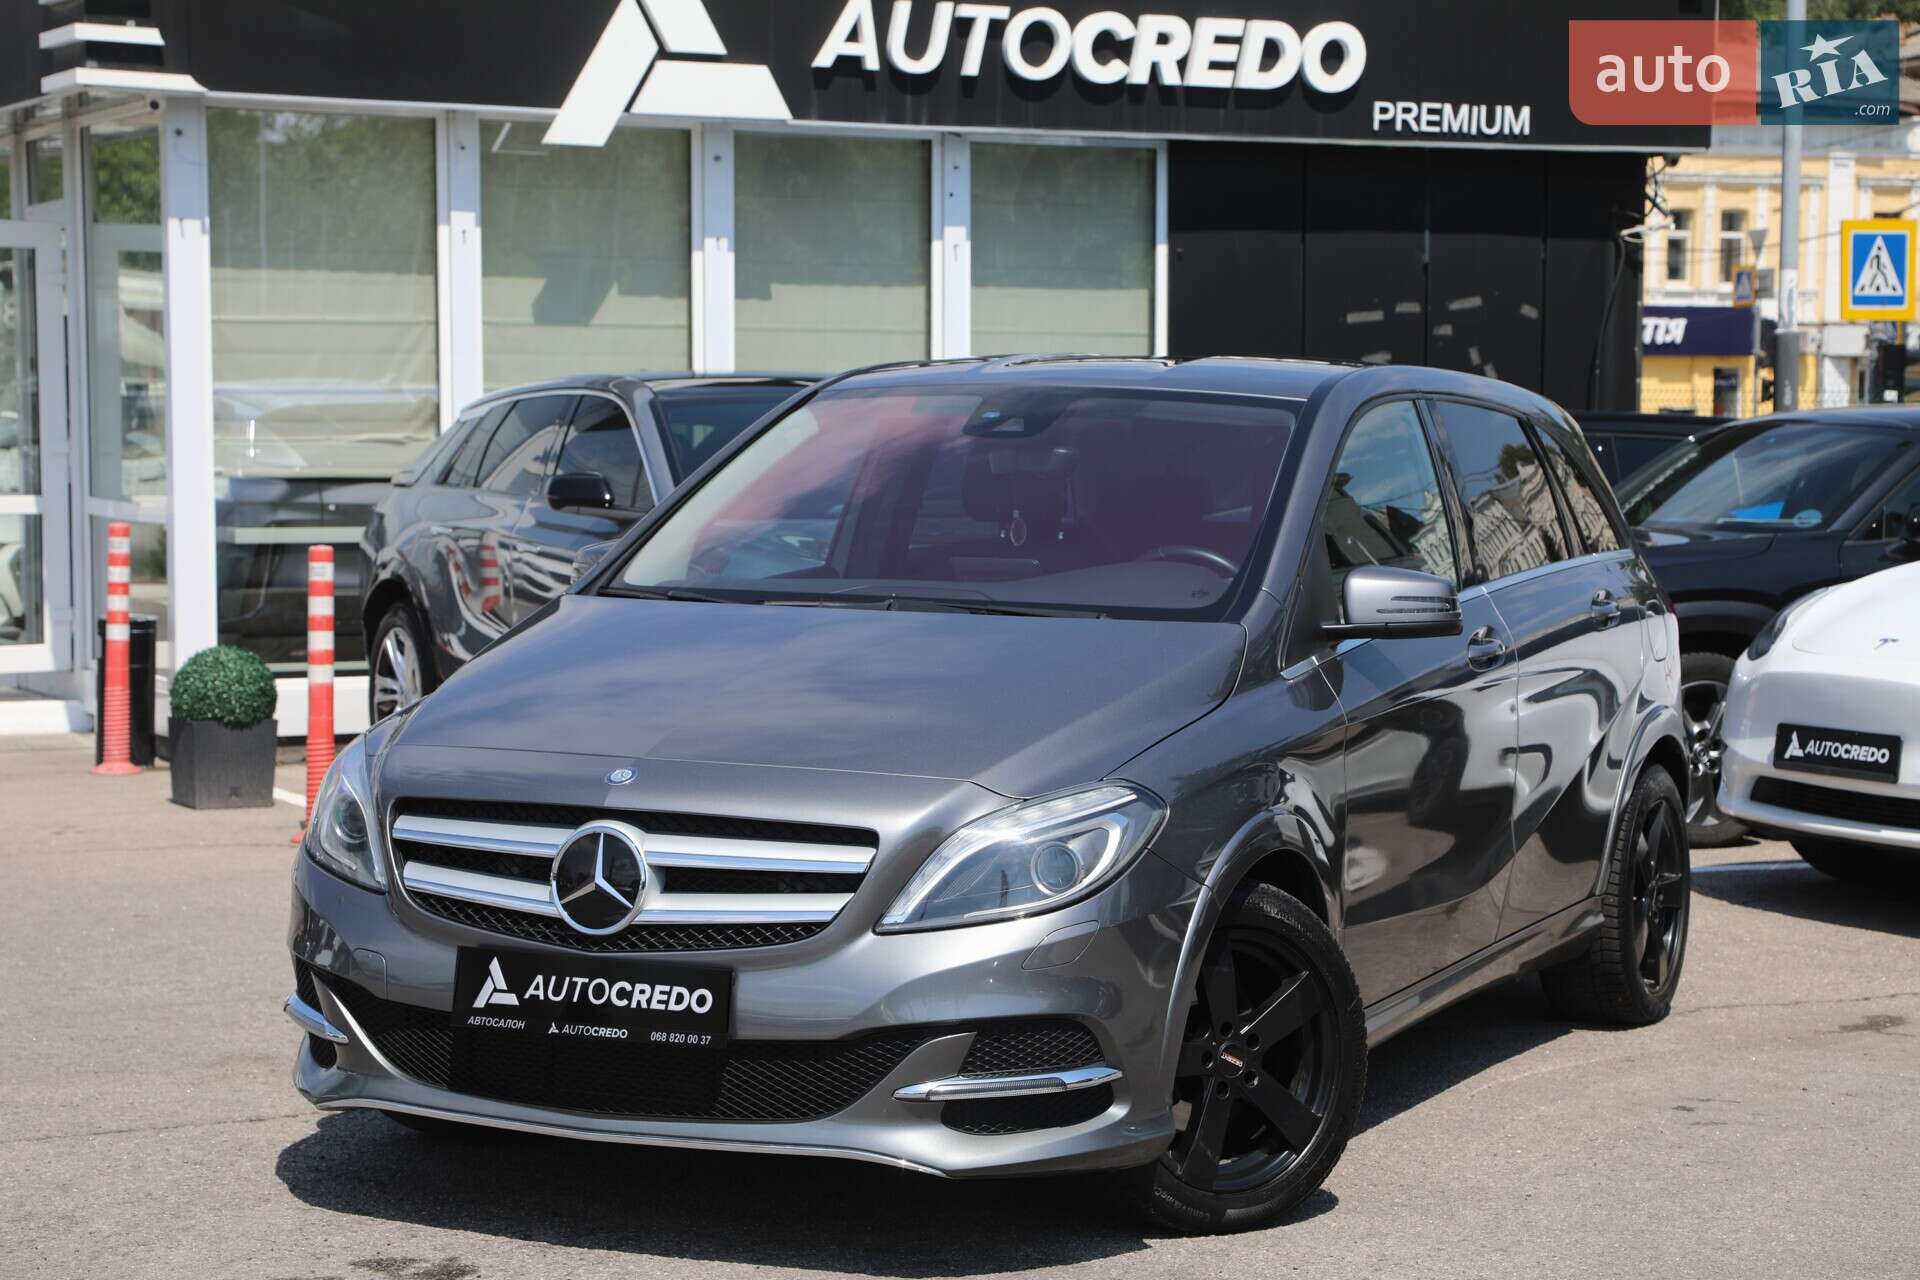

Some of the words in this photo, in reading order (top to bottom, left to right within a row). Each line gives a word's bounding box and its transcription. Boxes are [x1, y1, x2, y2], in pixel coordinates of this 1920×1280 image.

[811, 0, 1367, 94] AUTOCREDO
[1371, 101, 1531, 136] PREMIUM
[1804, 739, 1890, 764] AUTOCREDO
[523, 974, 713, 1014] AUTOCREDO
[467, 1016, 526, 1030] АВТОСАЛОН
[562, 1024, 628, 1039] AUTOCREDO
[650, 1031, 667, 1041] 068
[669, 1033, 685, 1043] 820
[687, 1034, 698, 1044] 00
[700, 1035, 711, 1045] 37
